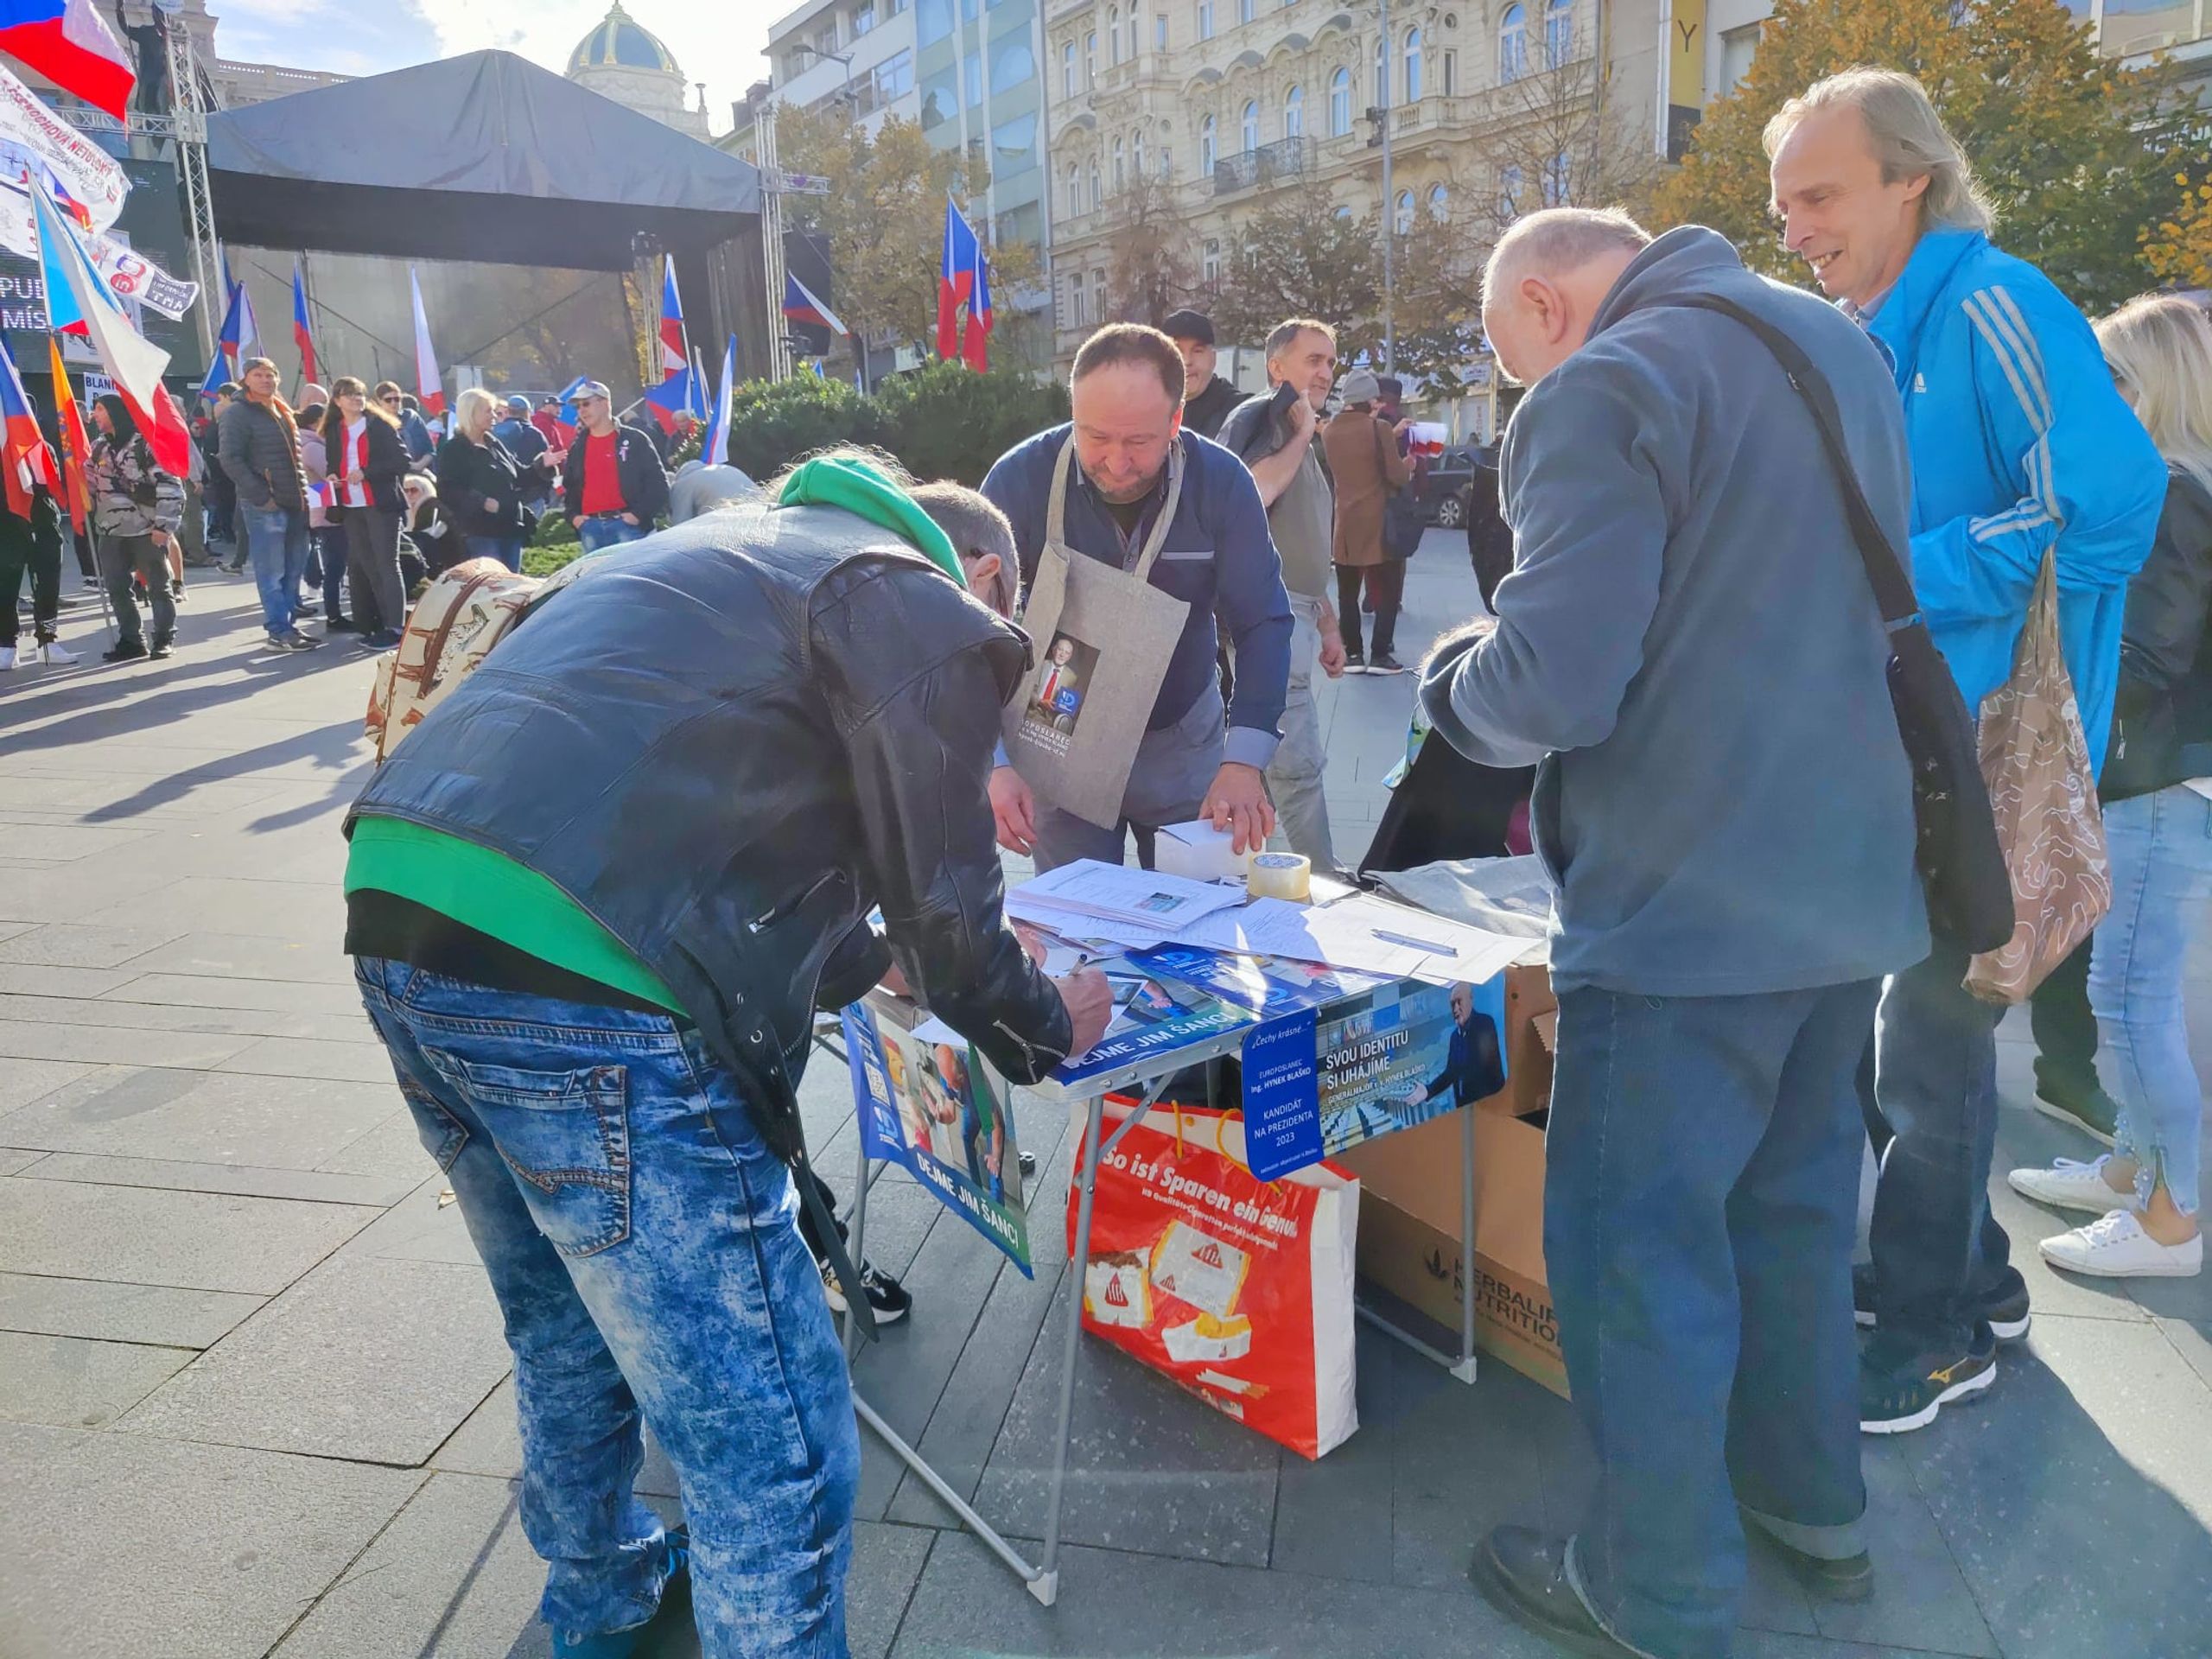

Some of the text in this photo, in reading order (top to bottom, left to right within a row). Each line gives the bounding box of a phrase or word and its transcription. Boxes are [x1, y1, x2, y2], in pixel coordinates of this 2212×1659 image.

[1678, 19, 1697, 53] Y
[1082, 1042, 1136, 1065] EJME
[1326, 1029, 1409, 1070] SVOU IDENTITU
[1327, 1054, 1390, 1090] SI UHÁJÍME
[1254, 1109, 1313, 1140] NA PREZIDENTA
[1263, 1097, 1303, 1121] KANDIDÁT
[1275, 1131, 1295, 1147] 2023
[916, 1151, 957, 1197] DEJME
[957, 1185, 980, 1217] JIM
[1103, 1146, 1128, 1169] So
[1129, 1154, 1159, 1181] ist
[1160, 1166, 1230, 1211] Sparen
[1233, 1198, 1260, 1224] ein
